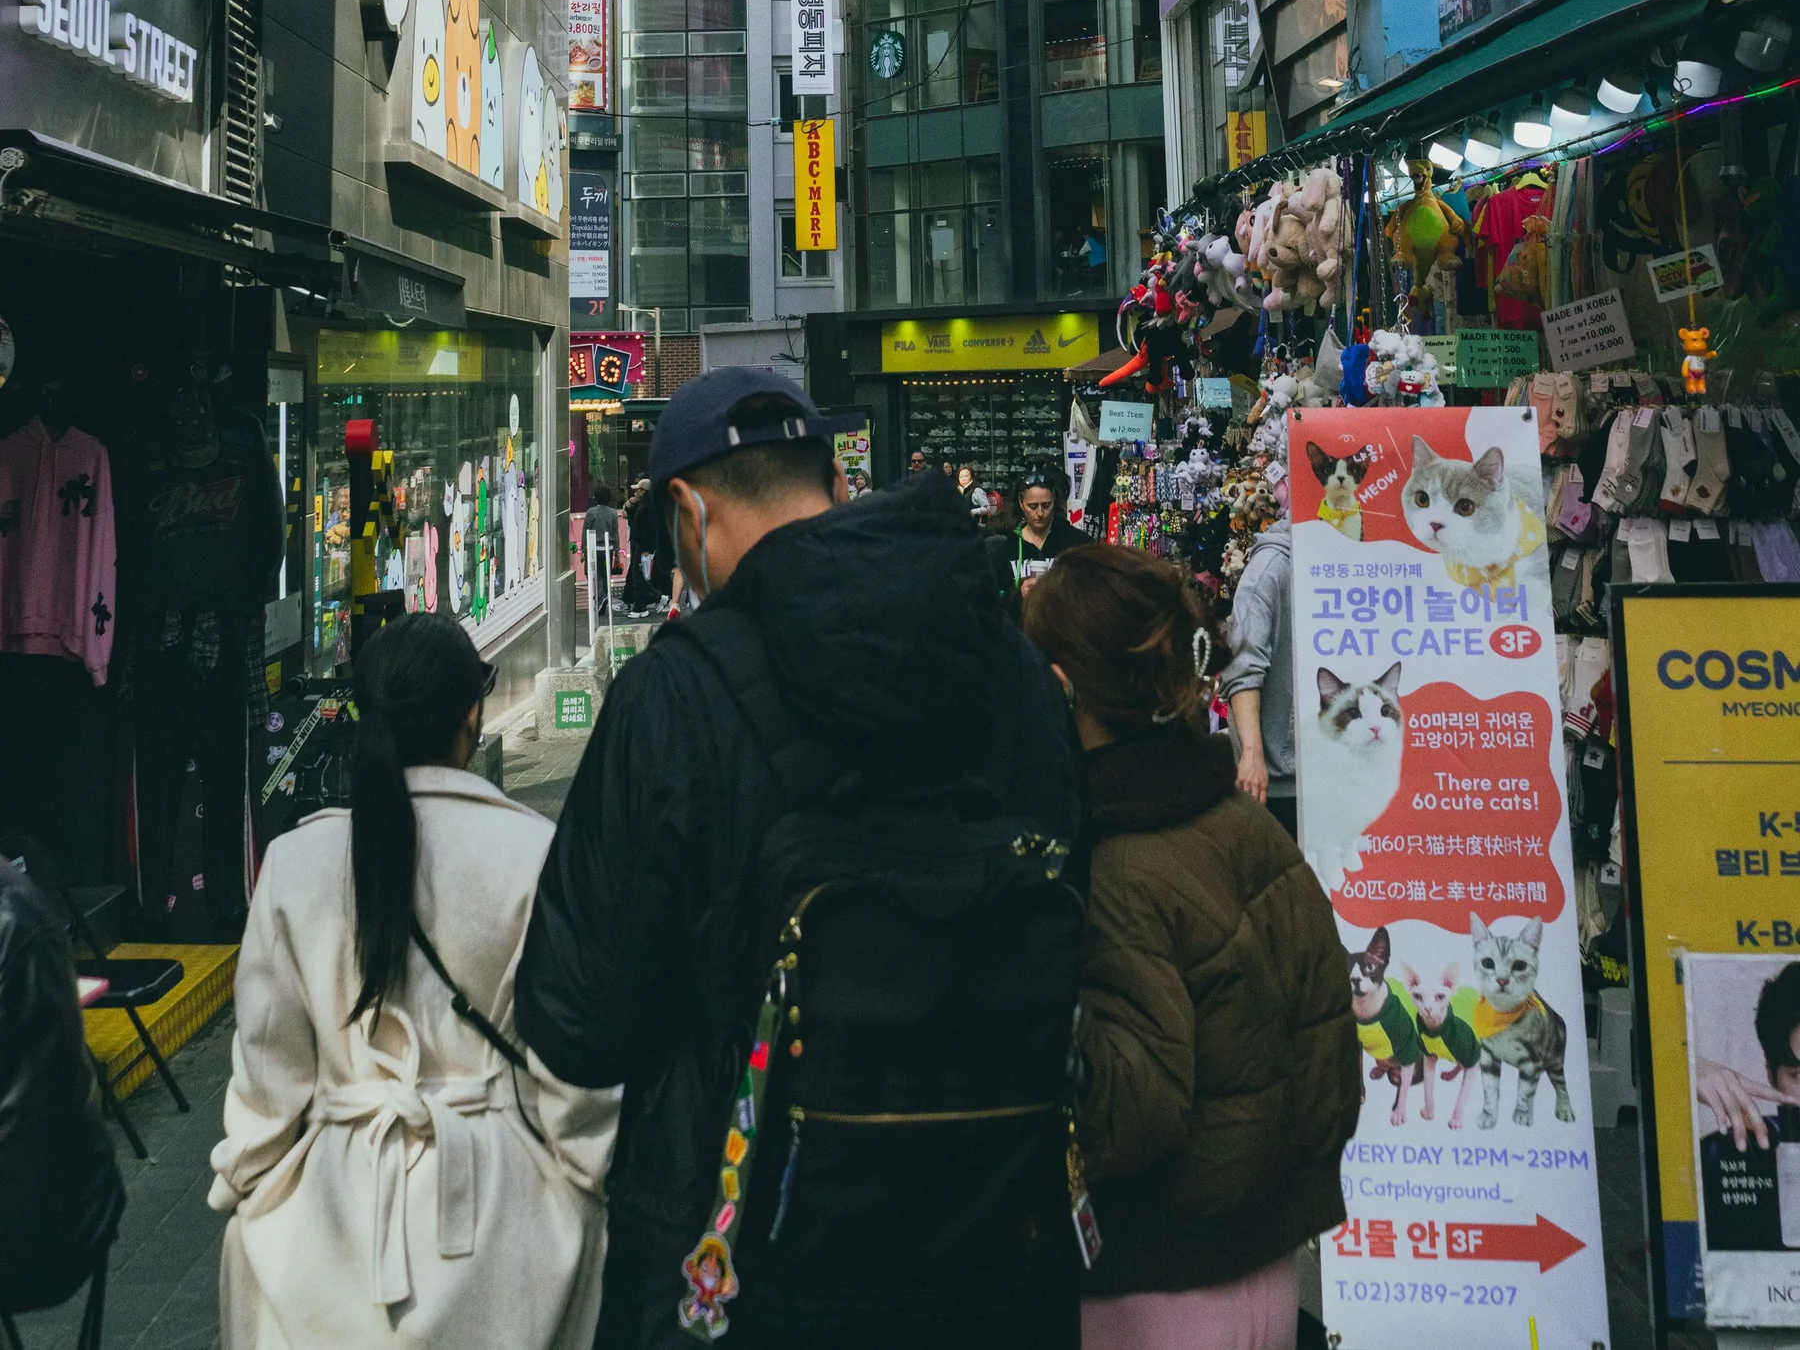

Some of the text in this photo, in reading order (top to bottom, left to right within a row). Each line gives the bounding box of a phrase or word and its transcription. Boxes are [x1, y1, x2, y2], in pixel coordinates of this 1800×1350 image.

[124, 11, 198, 103] STREET
[1546, 295, 1618, 324] MADE IN KOREA
[894, 340, 916, 352] FILA
[927, 334, 951, 348] VANS
[962, 338, 1007, 348] CONVERSE
[1461, 333, 1534, 342] MADE IN KOREA
[1109, 409, 1144, 419] Best Item
[1353, 444, 1385, 463] 냐옹!
[1359, 469, 1399, 503] MEOW
[1310, 563, 1423, 579] #명동고양이카페
[1312, 584, 1529, 623] 고양이 놀이터
[1313, 628, 1532, 656] CAT CAFE 3F
[562, 696, 585, 706] 쓰레기
[562, 705, 585, 715] 버리지
[561, 714, 587, 725] 마세요!
[1408, 712, 1534, 730] 60마리의 귀여운
[1411, 731, 1535, 749] 고양이가 있어요!
[1434, 772, 1530, 791] There are
[1412, 792, 1539, 811] 60 cute cats!
[1715, 848, 1769, 877] 멀티
[1343, 880, 1548, 903] 60匹の猫と幸せな時間
[1343, 1144, 1589, 1171] VERY DAY 12PM~23PM
[1332, 1218, 1483, 1260] 건물 안 3F
[1335, 1280, 1518, 1307] T.02)3789-2207
